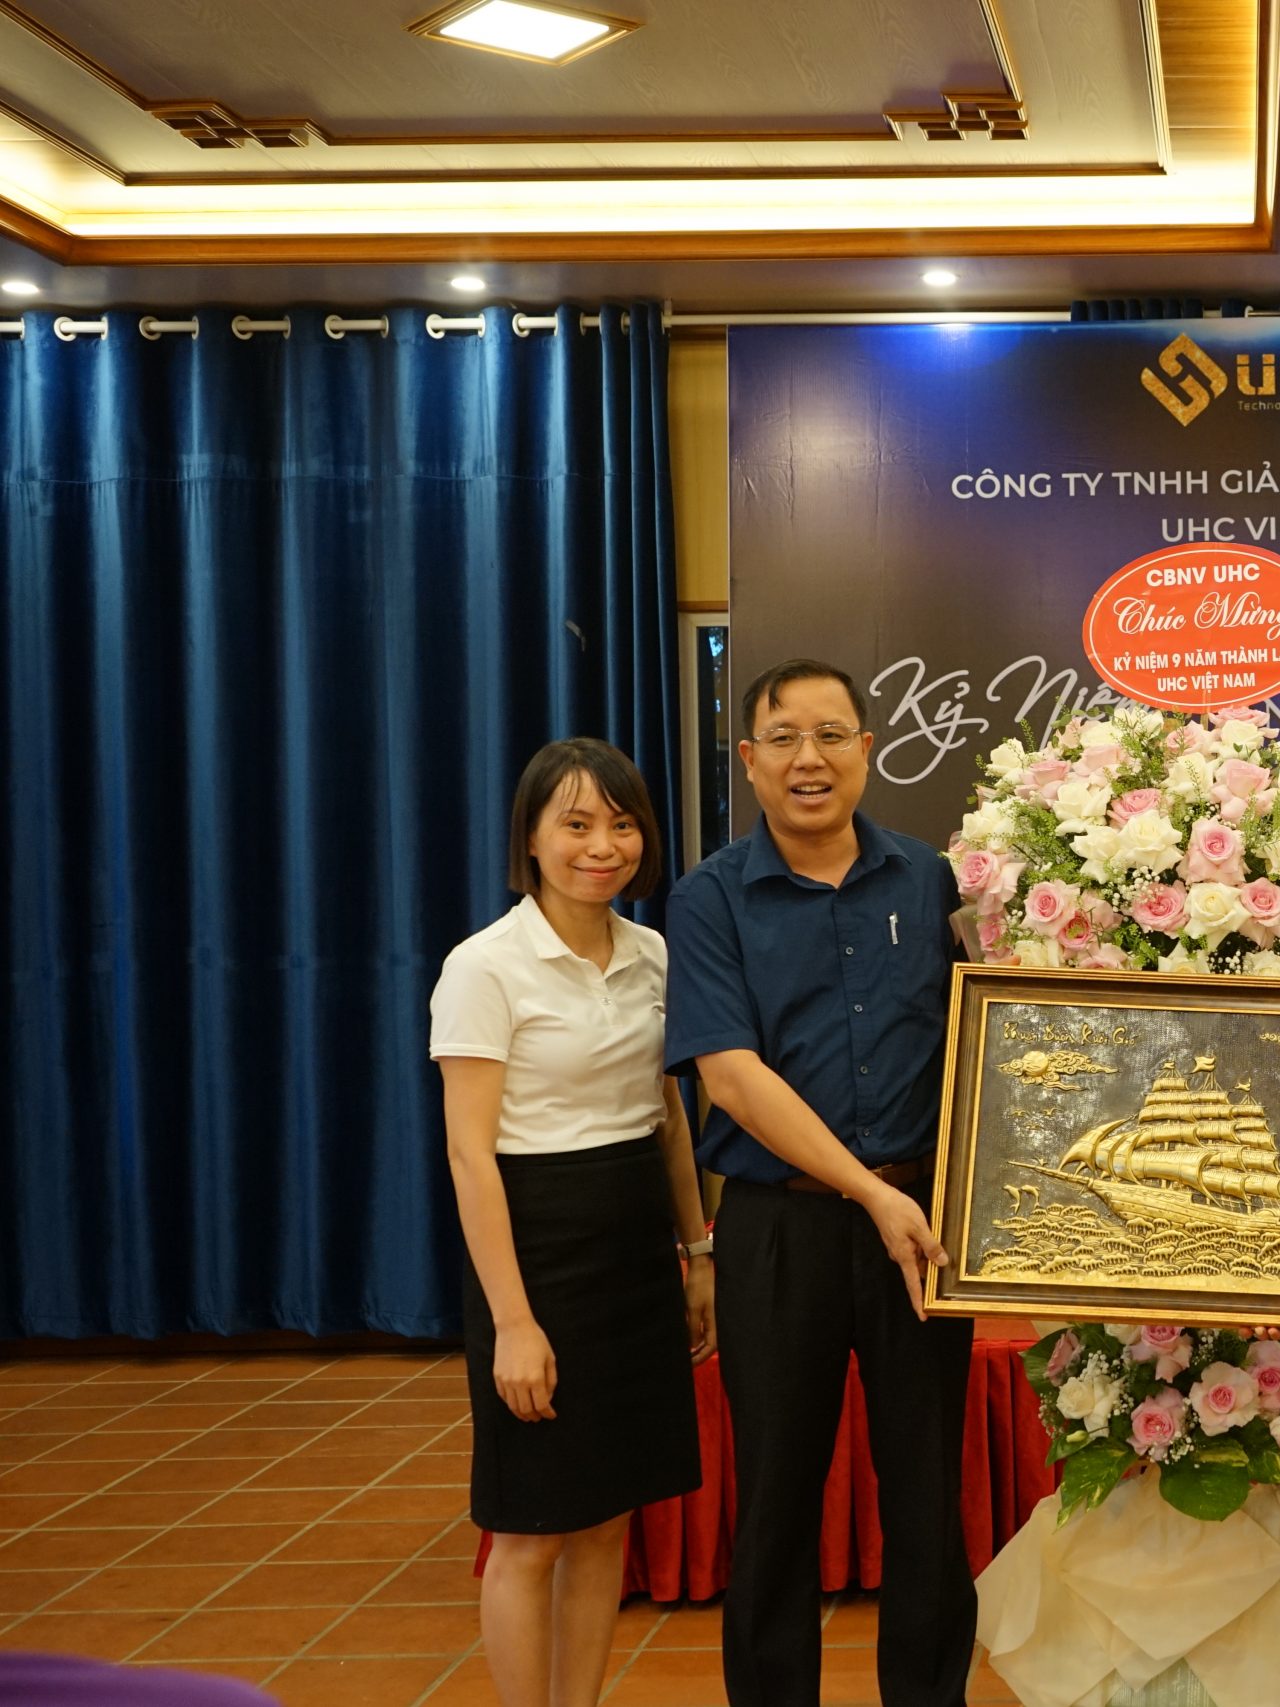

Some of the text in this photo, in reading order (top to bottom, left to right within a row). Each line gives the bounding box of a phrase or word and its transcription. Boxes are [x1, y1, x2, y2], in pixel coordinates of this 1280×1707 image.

[951, 468, 1051, 499] CÔNG
[1062, 472, 1103, 496] TY
[1112, 471, 1208, 496] TNHH
[1161, 516, 1235, 542] UHC
[1146, 563, 1260, 587] CBNV UHC
[1113, 597, 1186, 635] Chúc
[1114, 651, 1131, 672] KỶ
[1135, 652, 1168, 674] NIỆM
[1172, 653, 1180, 668] 9
[1185, 648, 1217, 666] NĂM
[1221, 646, 1268, 665] THÀNH
[1157, 672, 1256, 694] UHC VIỆT NAM
[869, 656, 989, 784] Kỷ
